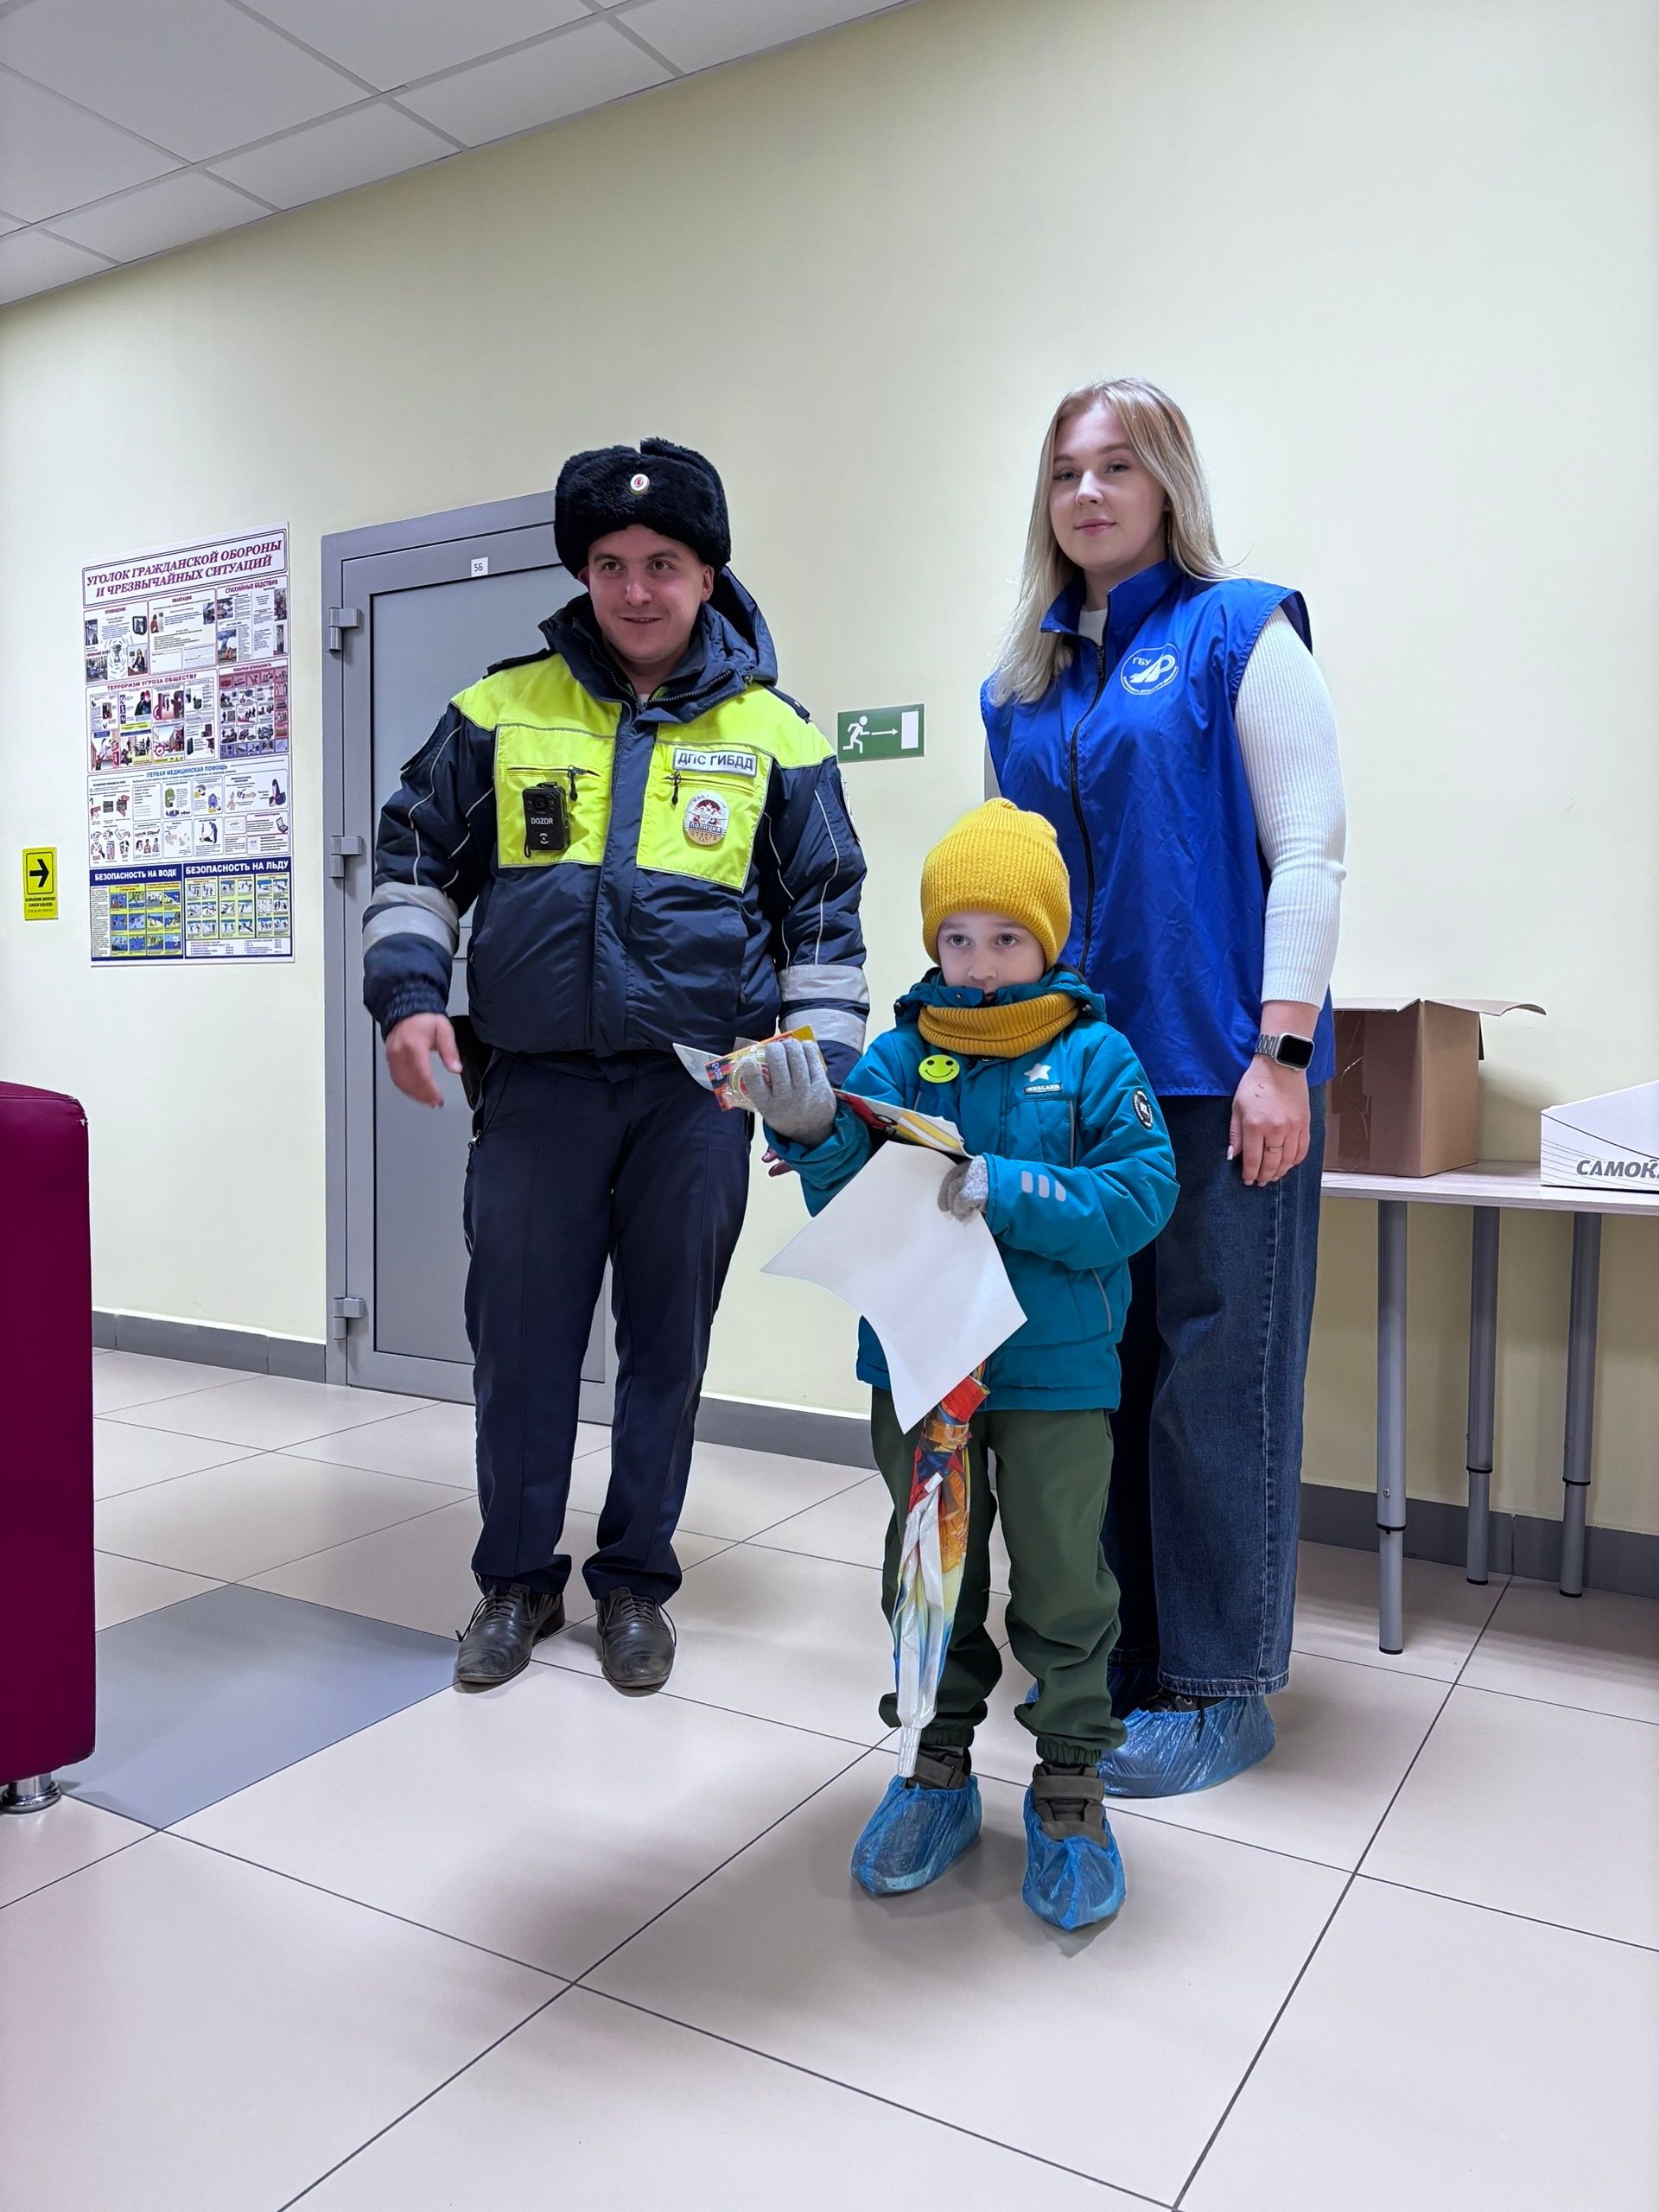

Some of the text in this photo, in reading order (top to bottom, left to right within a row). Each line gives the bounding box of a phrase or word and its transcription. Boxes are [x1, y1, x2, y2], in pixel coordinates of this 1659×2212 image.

[86, 540, 283, 587] УГОЛОК ГРАЖДАНСКОЙ ОБОРОНЫ
[474, 563, 484, 572] 56
[96, 554, 273, 598] И ЧРЕЗВЫЧАЙНЫХ СИТУАЦИЙ
[1132, 657, 1152, 666] ГБУ
[107, 674, 197, 691] ТЕРРОРИЗМ УГРОЗА ОБЩЕСТВУ
[677, 753, 753, 772] ДПС ГИБДД
[167, 766, 204, 776] МЕДИЦИНСКАЯ
[531, 817, 554, 825] DOZOR
[186, 860, 289, 874] БЕЗОПАСНОСТЬ НА ЛЬДУ
[94, 868, 177, 881] БЕЗОПАСНОСТЬ НА ВОДЕ
[1576, 1160, 1659, 1179] САМОК
